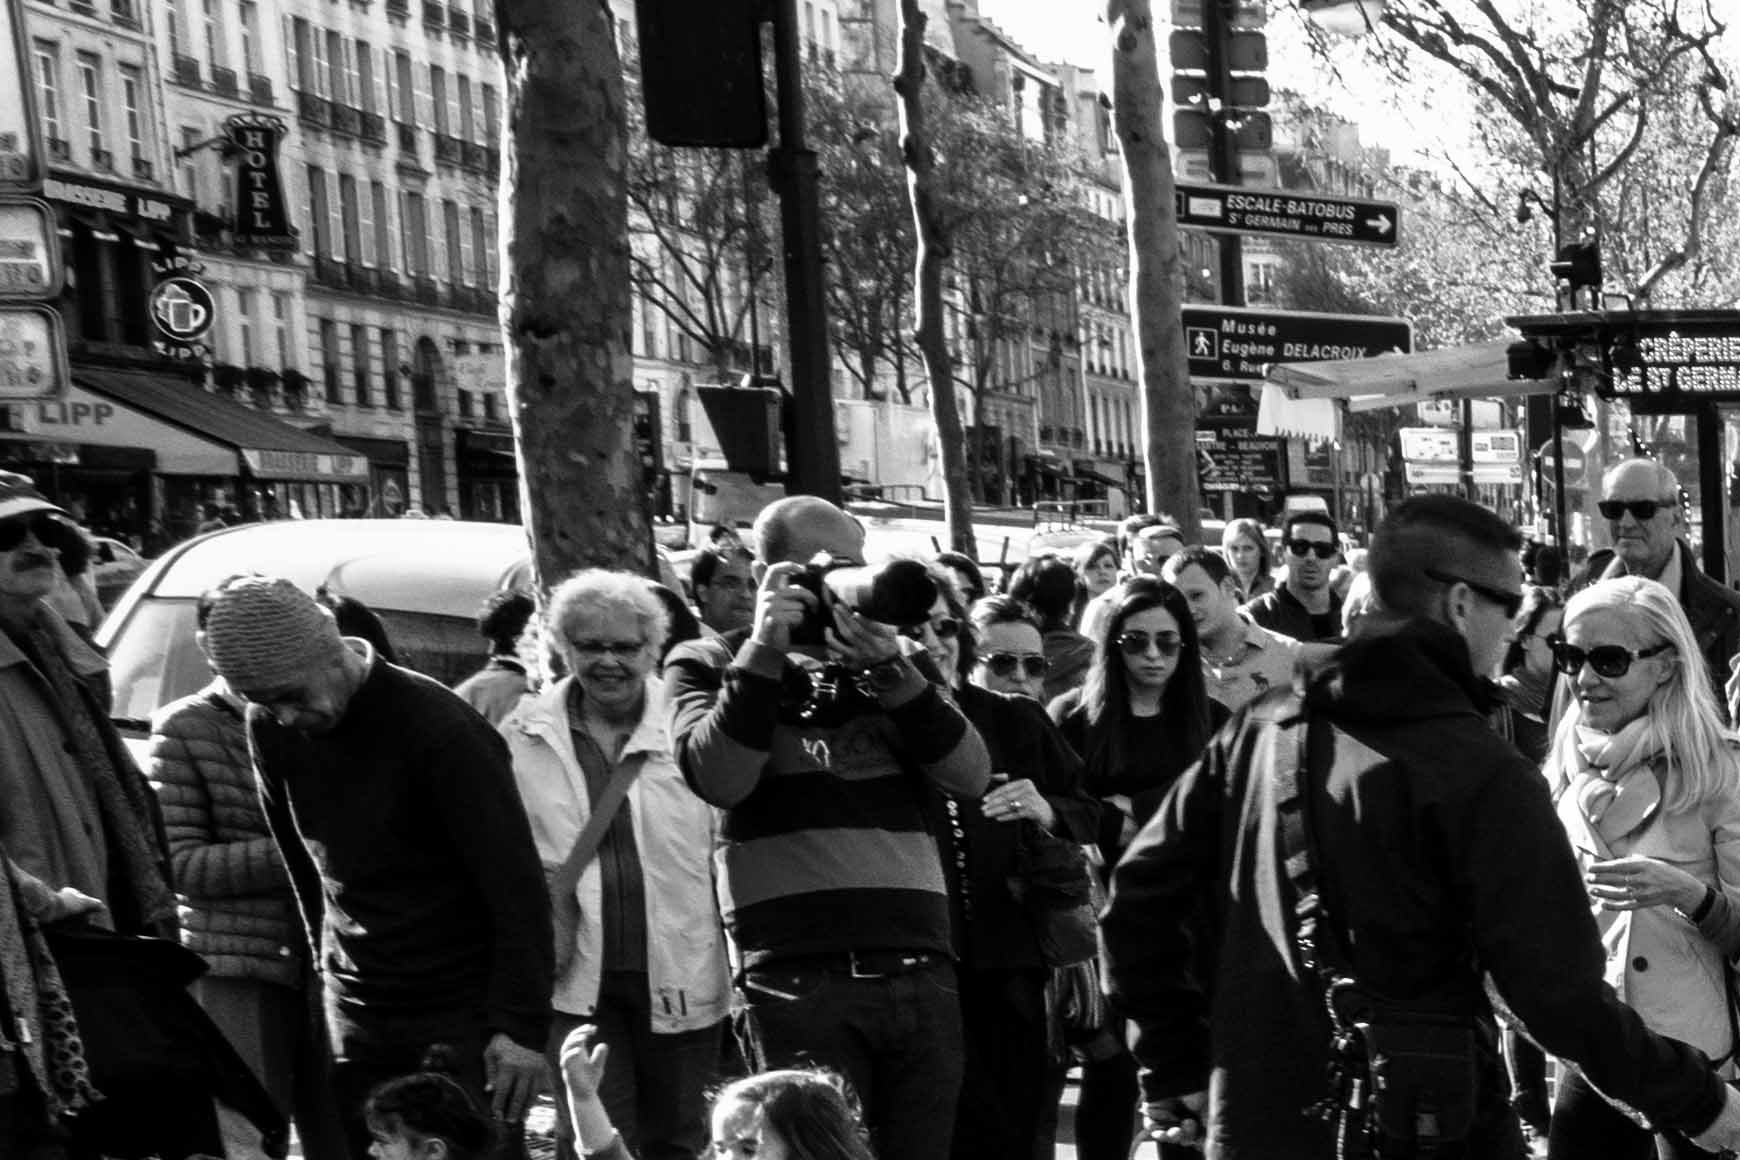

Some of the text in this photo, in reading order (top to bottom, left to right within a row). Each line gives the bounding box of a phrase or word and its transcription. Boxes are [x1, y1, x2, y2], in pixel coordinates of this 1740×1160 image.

[245, 131, 272, 229] HOTEL
[1226, 194, 1356, 220] ESCALE-BATOBUS
[1244, 213, 1301, 230] GERMAIN
[1221, 319, 1276, 337] Musée
[1221, 339, 1367, 361] Eugène DELACROIX
[39, 400, 114, 426] LIPP
